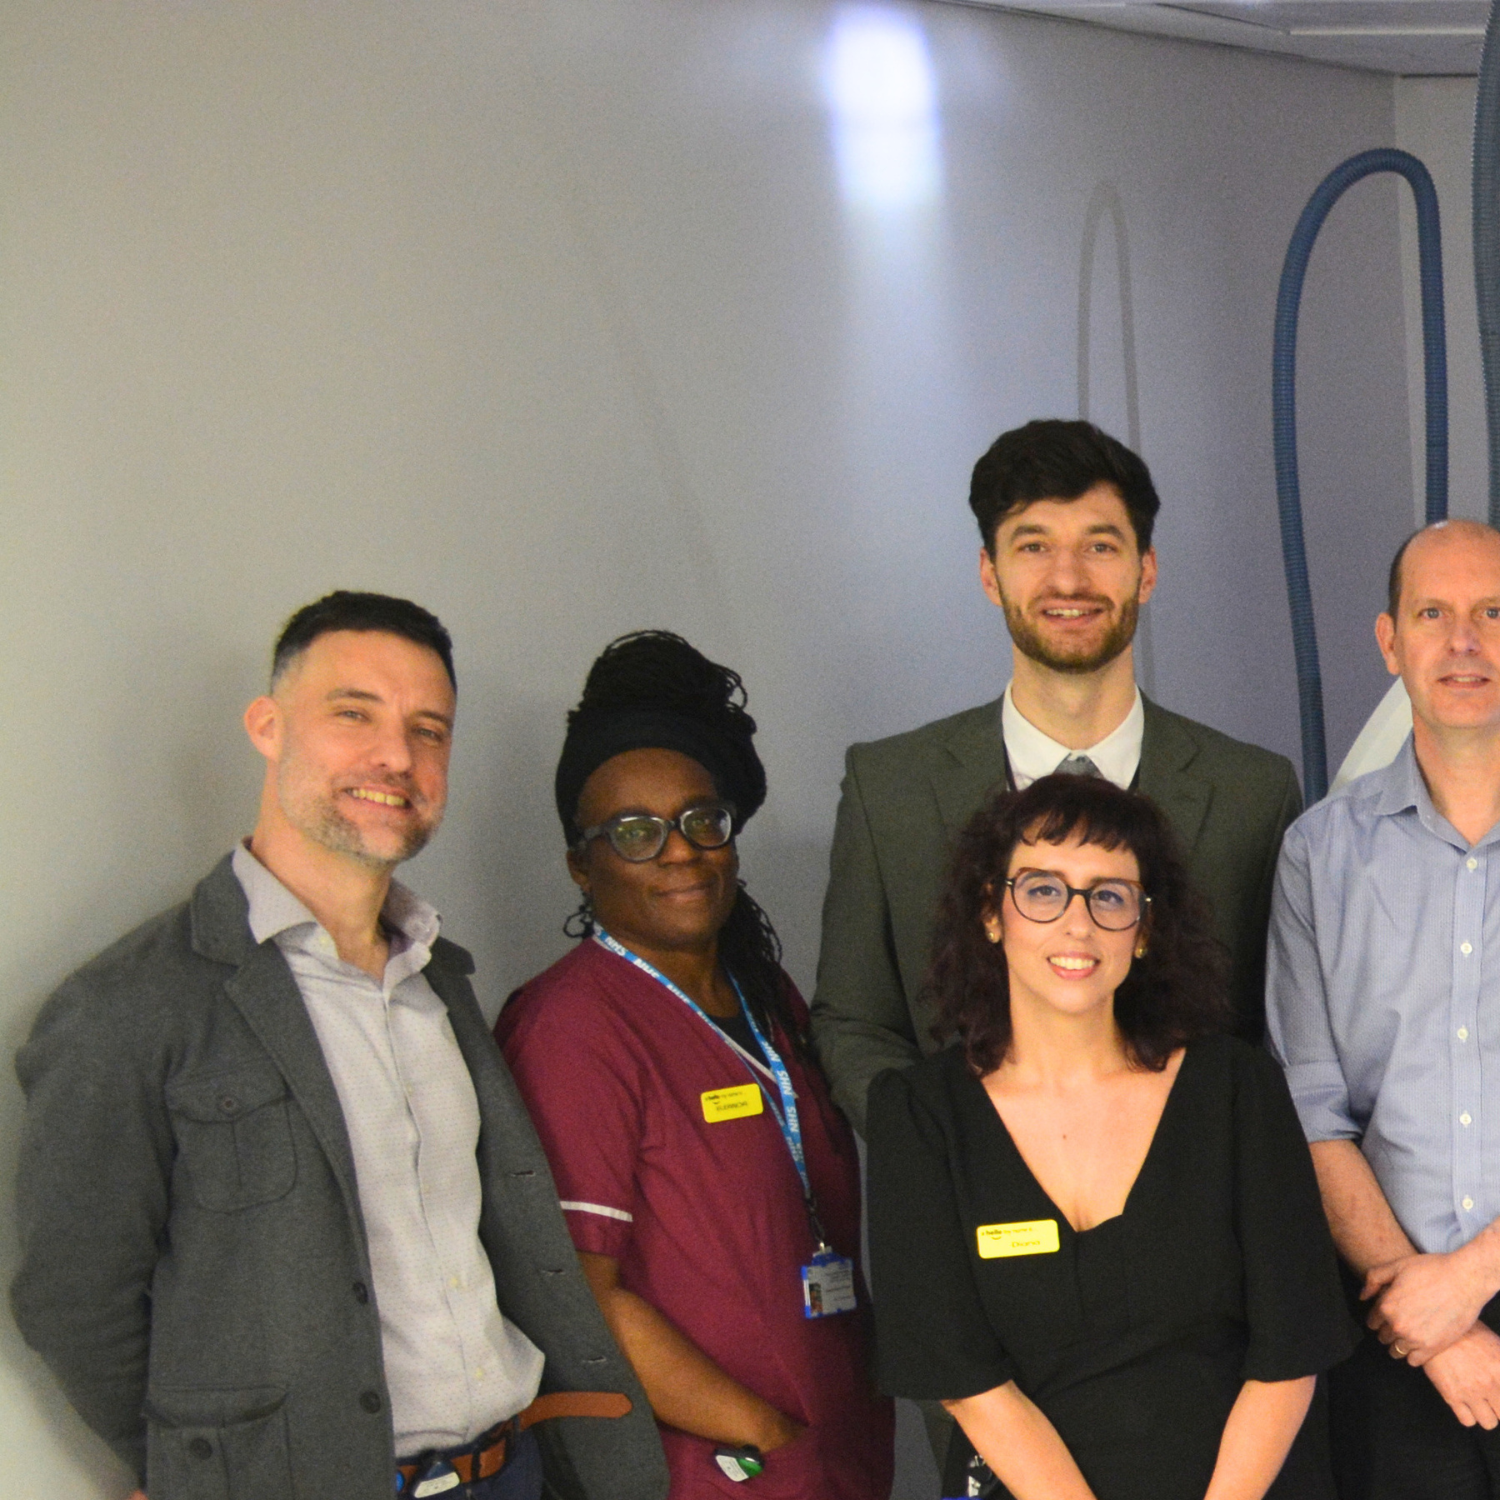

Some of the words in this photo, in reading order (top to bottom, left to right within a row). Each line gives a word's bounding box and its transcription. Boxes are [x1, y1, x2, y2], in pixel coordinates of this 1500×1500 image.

[605, 936, 626, 956] NHS
[777, 1070, 792, 1096] NHS
[786, 1106, 799, 1132] NHS
